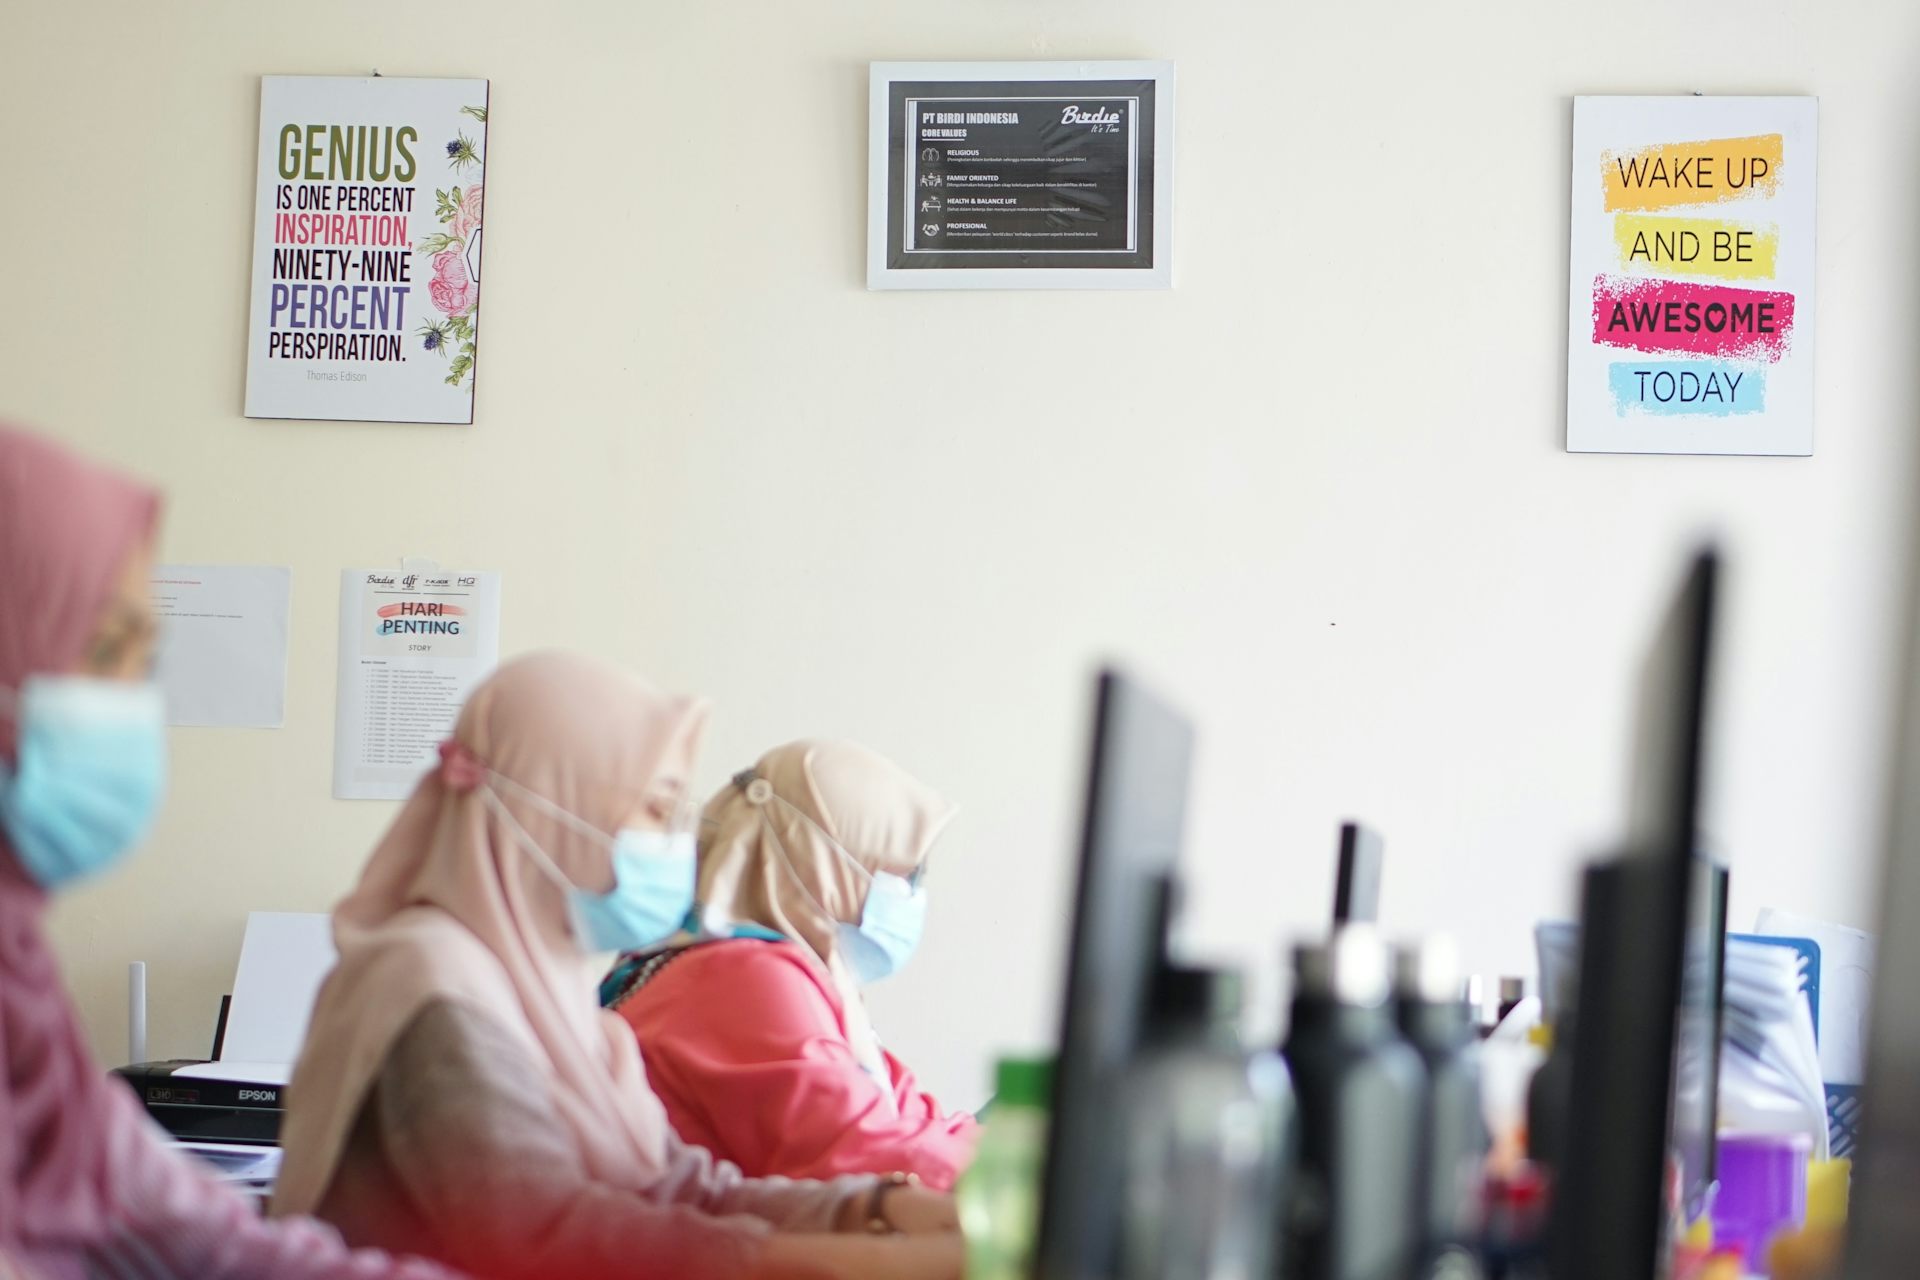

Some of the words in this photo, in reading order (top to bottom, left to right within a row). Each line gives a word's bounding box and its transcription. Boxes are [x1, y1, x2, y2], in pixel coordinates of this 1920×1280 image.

[922, 112, 936, 124] PT
[937, 112, 965, 124] BIRDI
[967, 112, 1019, 124] INDONESIA
[1061, 105, 1120, 124] Birdie
[921, 128, 941, 138] CORE
[941, 128, 967, 138] VALUES
[278, 124, 418, 183] GENIUS
[1617, 157, 1714, 189] WAKE
[1726, 157, 1769, 188] UP
[276, 185, 292, 210] IS
[297, 185, 331, 211] ONE
[336, 186, 416, 213] PERCENT
[274, 213, 413, 249] INSPIRATION,
[1629, 231, 1701, 263] AND
[1713, 232, 1753, 262] BE
[272, 249, 412, 282] NINETY-NINE
[270, 284, 411, 331] PERCENT
[1607, 302, 1776, 334] AWESOME
[268, 331, 407, 362] PERSPIRATION.
[306, 370, 338, 382] Thomas
[340, 370, 368, 382] Edison
[1634, 371, 1744, 402] TODAY
[457, 577, 476, 585] HQ
[401, 602, 444, 617] HARI
[382, 619, 460, 635] PENTING
[408, 644, 432, 652] STORY
[238, 1089, 276, 1101] EPSON
